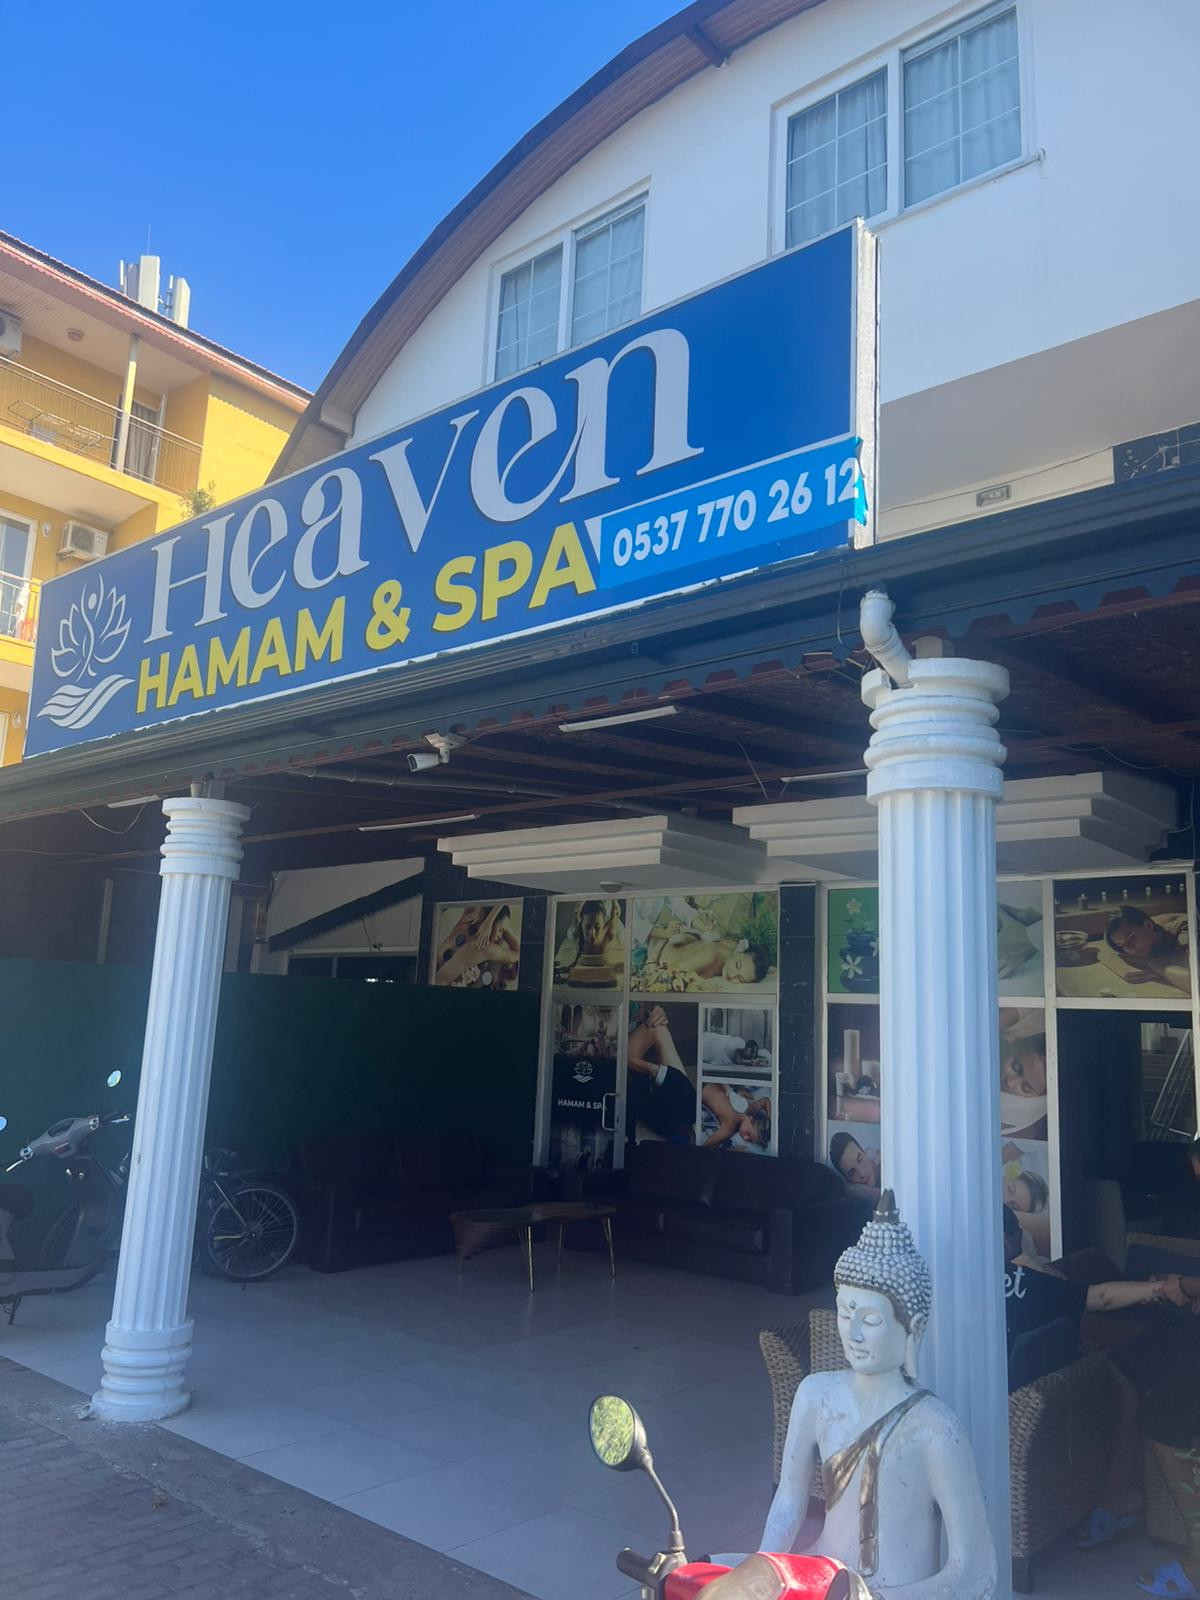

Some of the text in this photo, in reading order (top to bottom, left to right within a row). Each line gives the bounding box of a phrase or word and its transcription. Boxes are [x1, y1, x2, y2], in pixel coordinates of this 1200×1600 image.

[143, 328, 705, 644] Heaven
[612, 457, 859, 567] 0537 770 26 12
[136, 521, 597, 714] HAMAM & SPA
[558, 1098, 585, 1108] HAMAM
[586, 1101, 591, 1109] &
